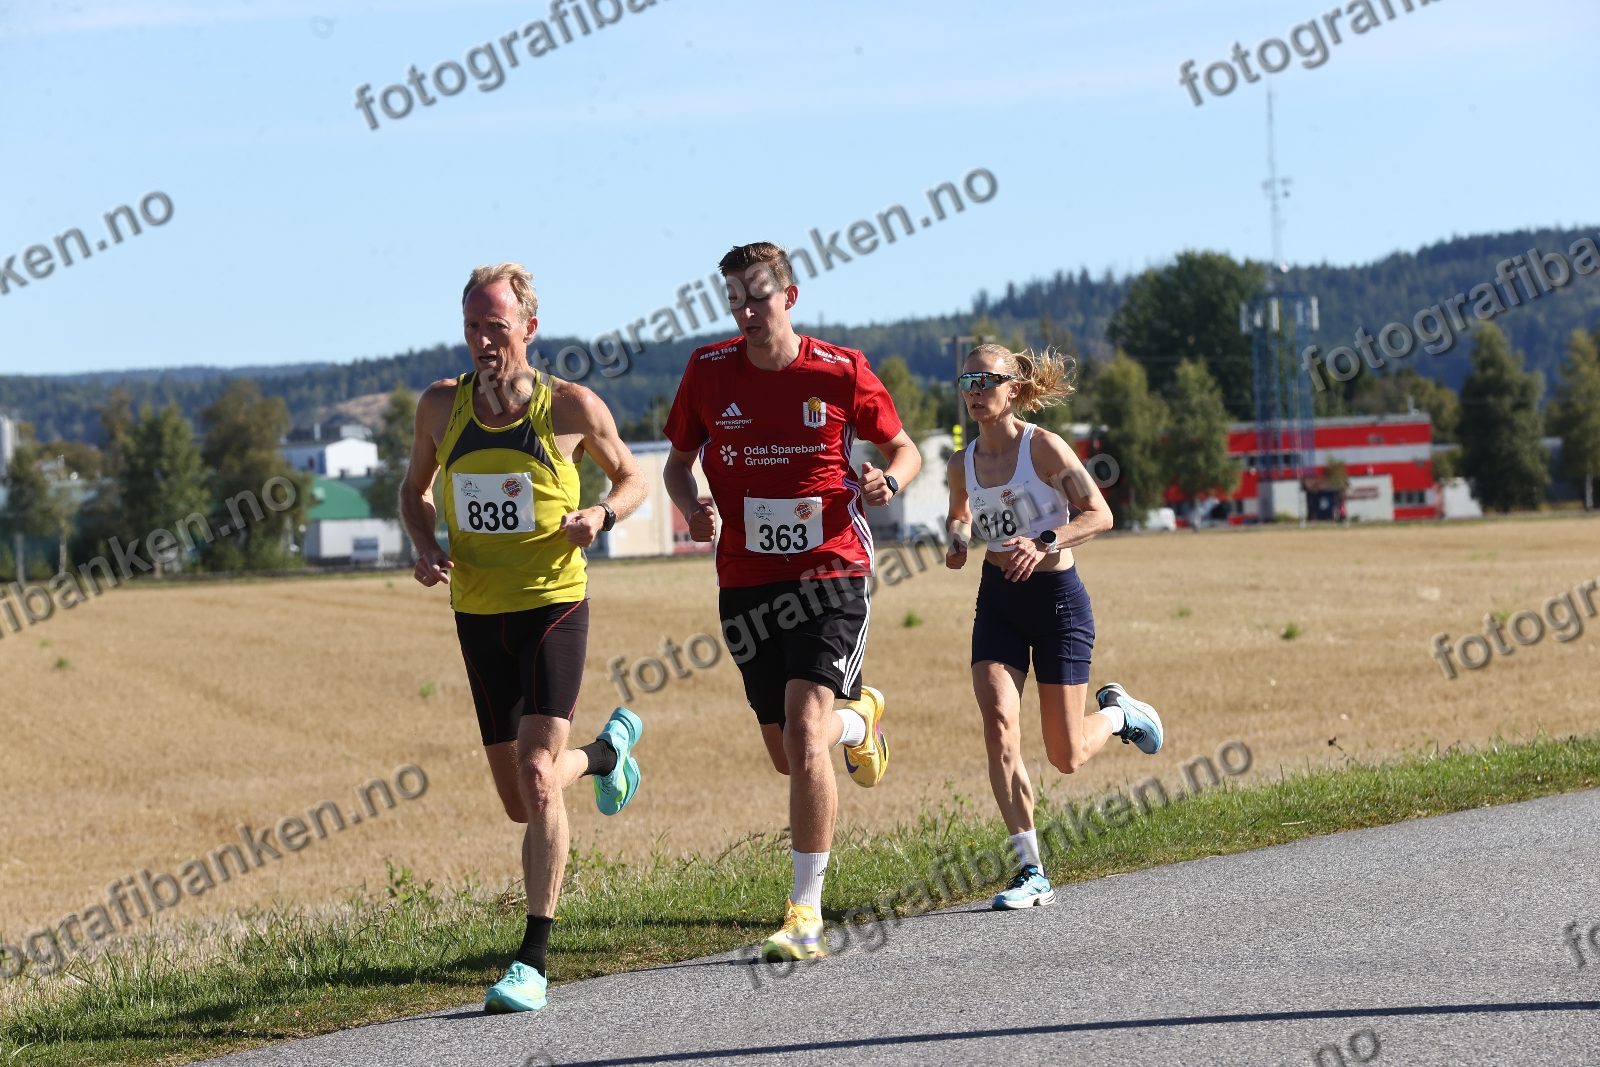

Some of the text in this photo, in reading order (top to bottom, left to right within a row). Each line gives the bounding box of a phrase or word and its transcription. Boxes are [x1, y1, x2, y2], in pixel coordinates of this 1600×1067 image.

[743, 443, 827, 457] Odal Sparebank
[745, 457, 790, 466] Gruppen
[468, 500, 519, 531] 838
[759, 523, 809, 551] 363
